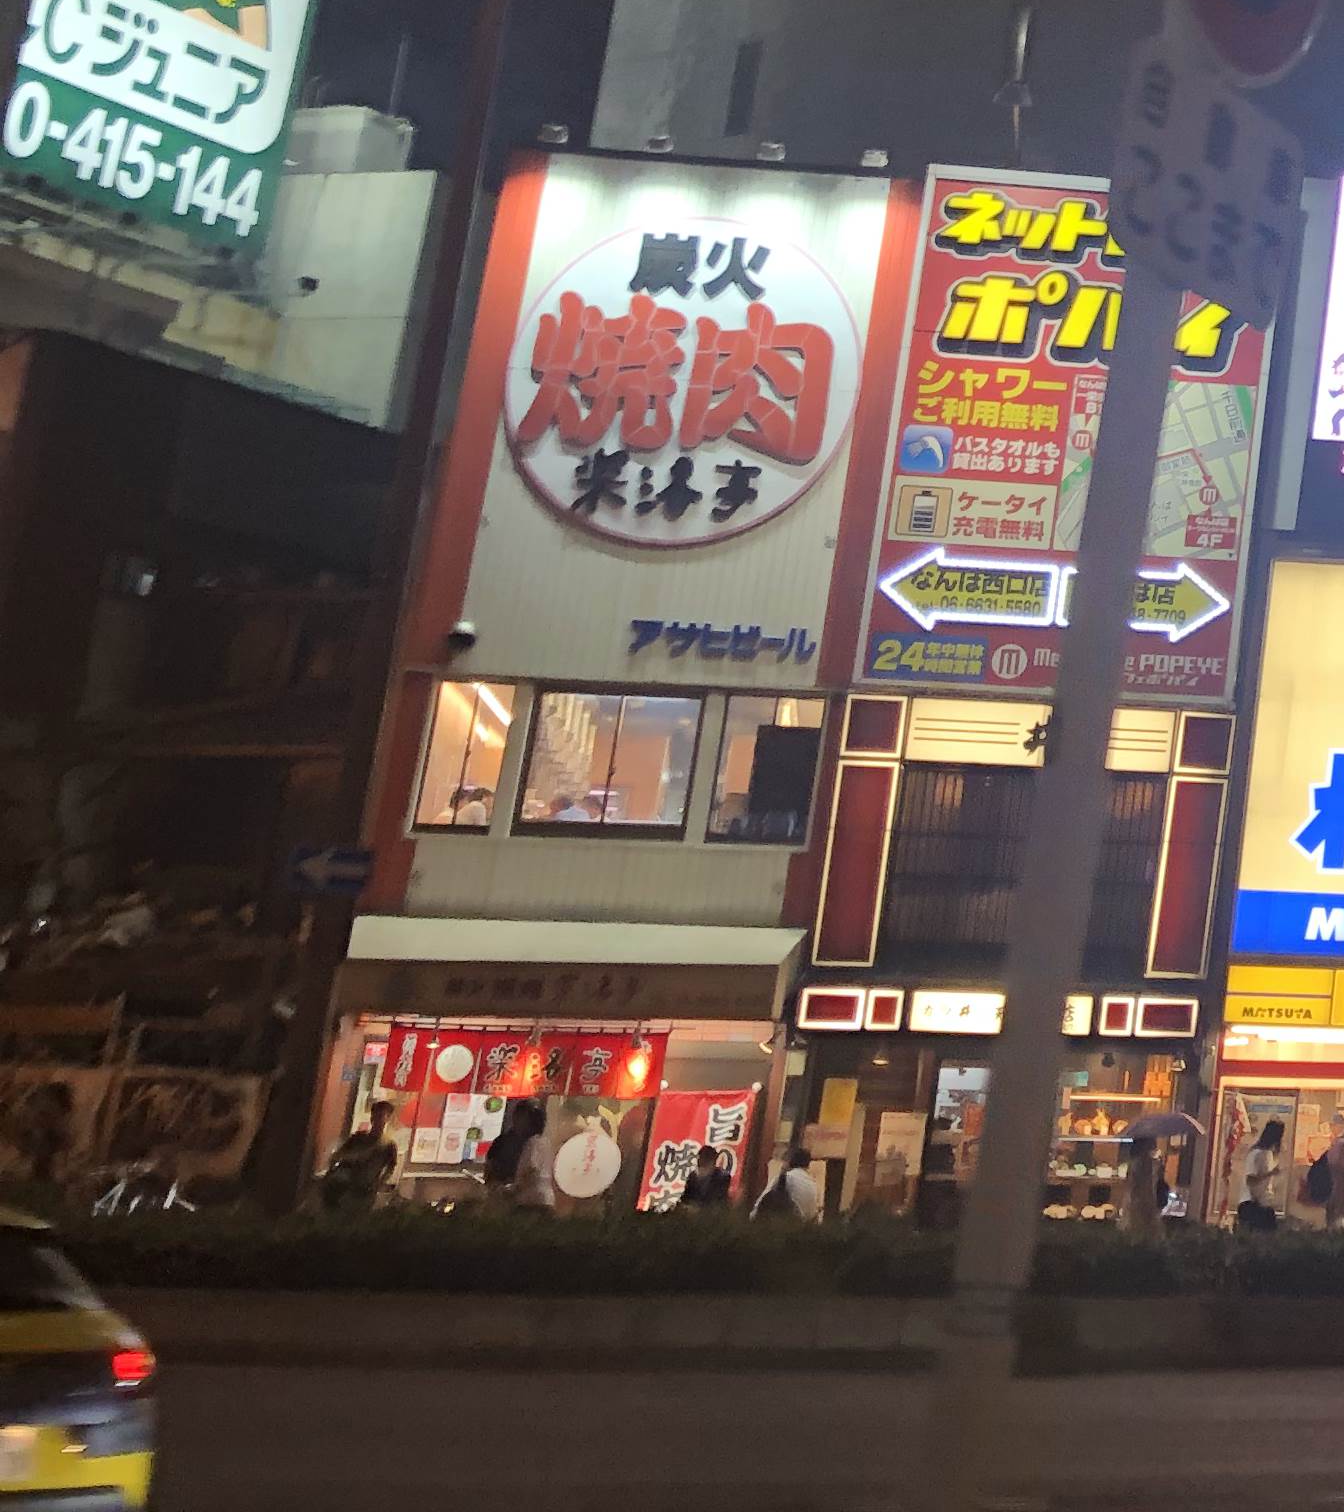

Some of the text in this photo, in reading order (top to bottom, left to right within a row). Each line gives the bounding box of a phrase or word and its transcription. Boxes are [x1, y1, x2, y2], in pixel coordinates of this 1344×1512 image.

[943, 190, 1126, 257] ネット
[628, 232, 772, 301] 炭火
[518, 289, 836, 466] 焼肉
[917, 359, 1068, 399] シャワー
[912, 396, 1060, 433] ご利用無料
[954, 435, 1062, 458] バスタオルも
[952, 452, 1060, 476] 貸出あります
[957, 491, 1048, 517] ケータイ
[951, 515, 1045, 542] 充電無料
[1196, 533, 1224, 547] 4F
[628, 618, 818, 665] アサヒビール
[873, 639, 926, 673] 24
[1139, 654, 1225, 676] POPEYE
[1241, 1005, 1314, 1020] MATSUYA
